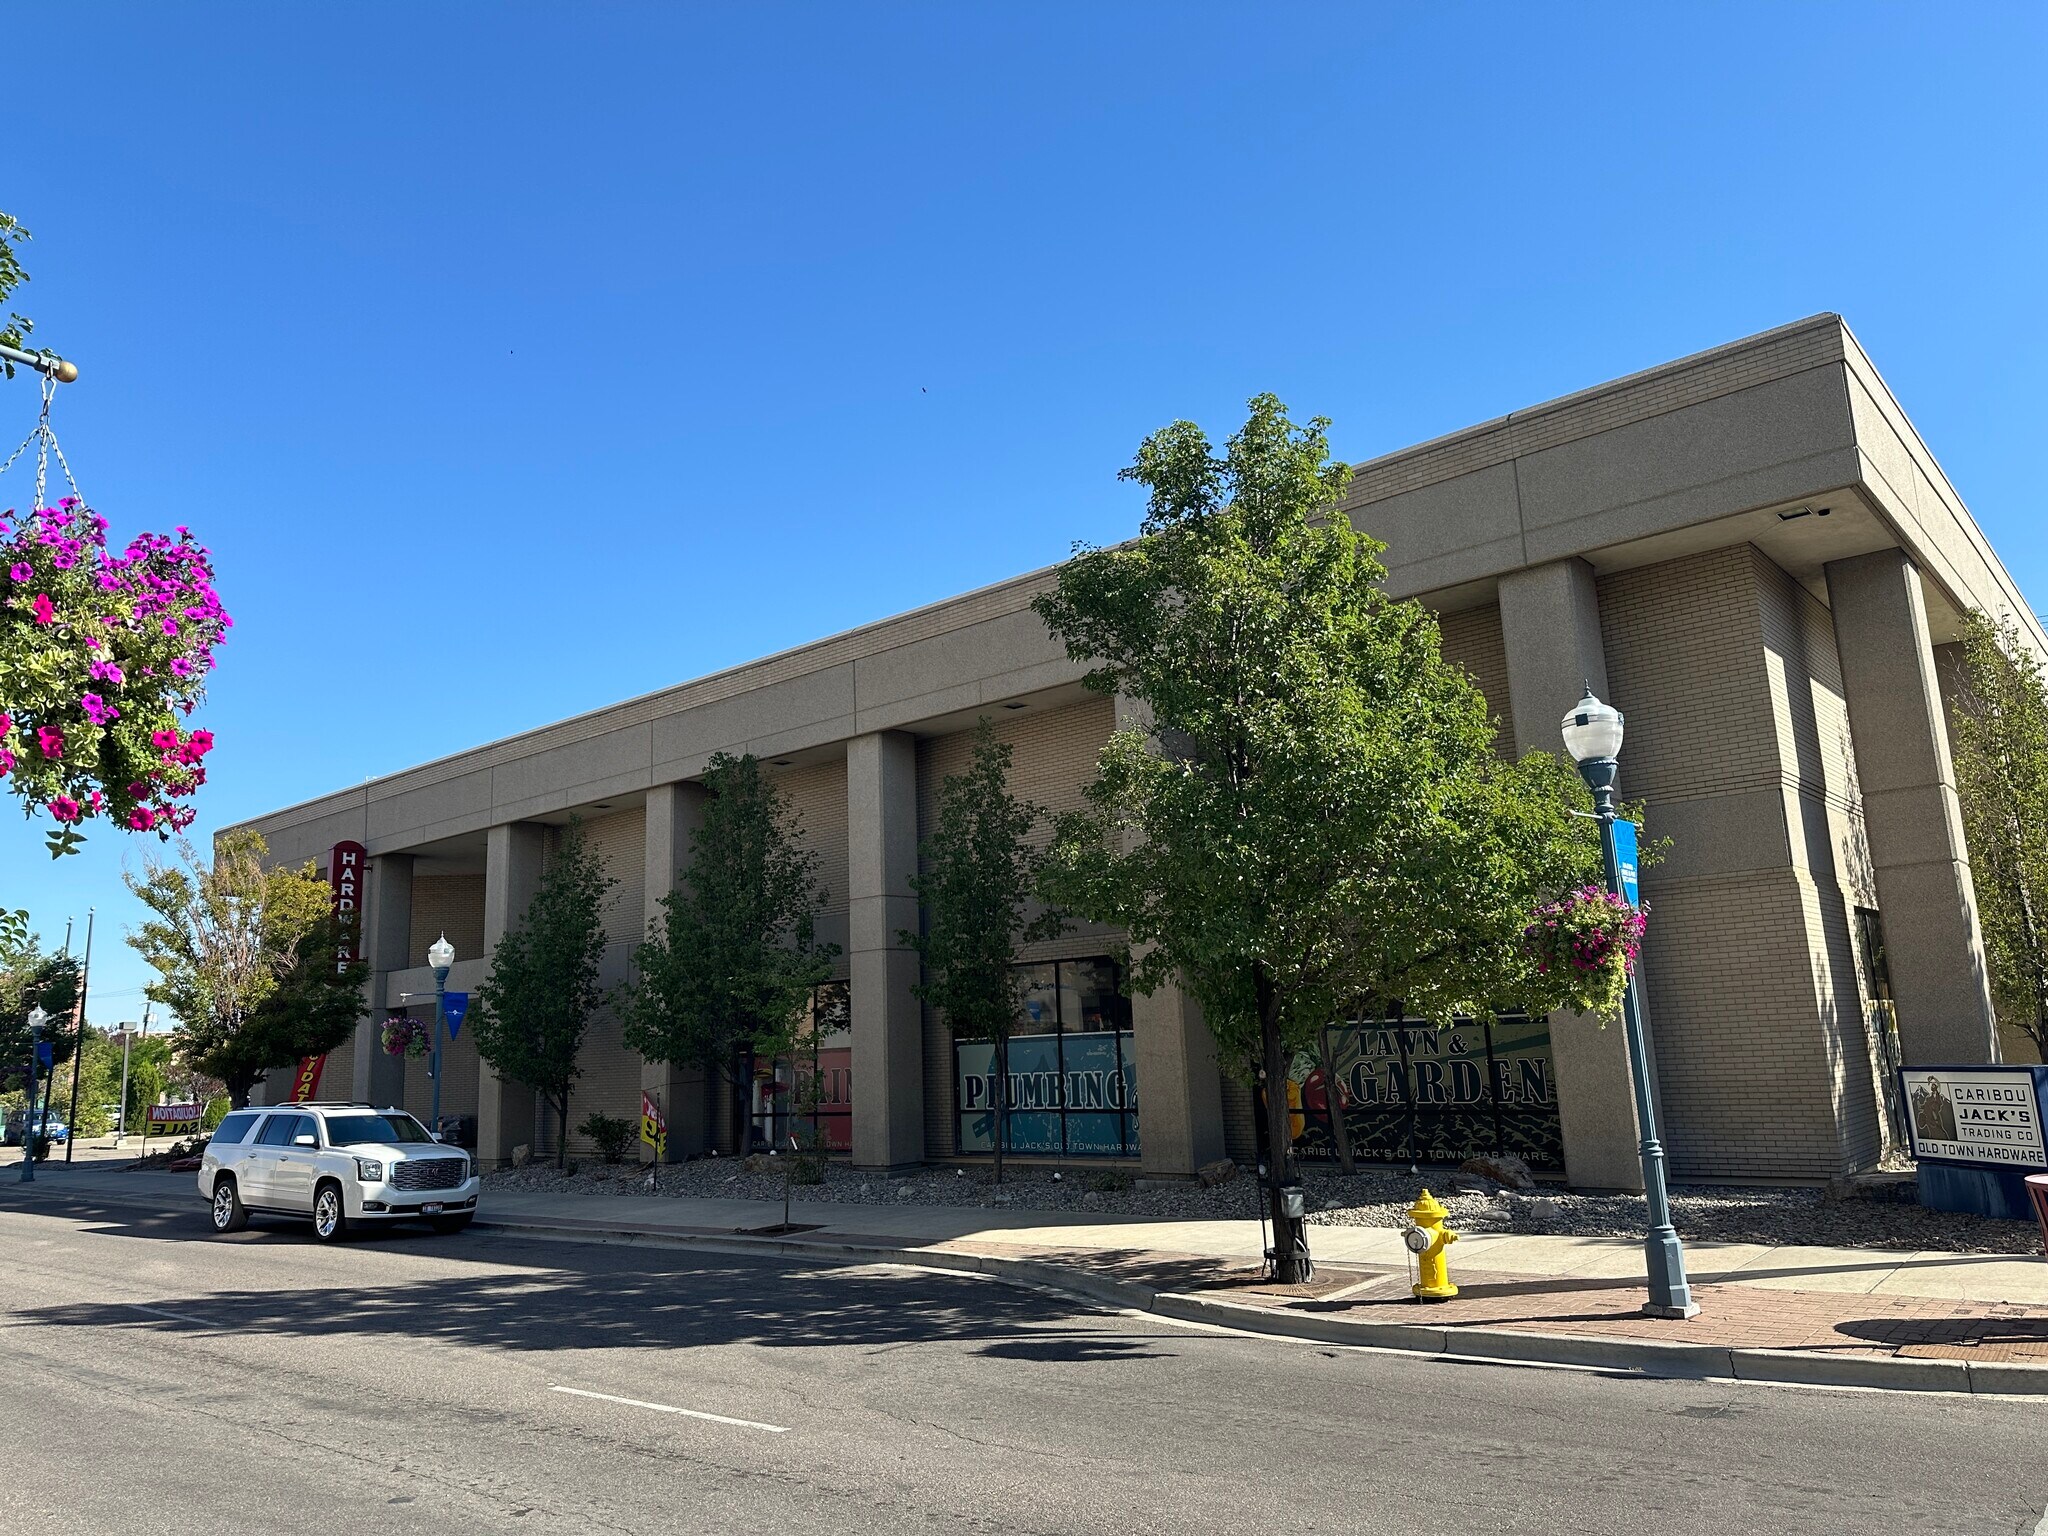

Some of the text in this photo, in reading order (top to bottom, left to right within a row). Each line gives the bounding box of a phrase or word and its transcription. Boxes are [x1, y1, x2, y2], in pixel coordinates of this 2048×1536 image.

[1358, 1028, 1469, 1057] LAWN &
[1349, 1058, 1549, 1104] GARDEN
[963, 1070, 1128, 1110] PLUMBING
[1954, 1088, 2027, 1102] CARIBOU
[1959, 1108, 2031, 1123] JACK'S
[1961, 1127, 2033, 1141] TRADING CO
[980, 1141, 1017, 1149] CARBU
[1020, 1141, 1051, 1150] JACK'S
[1053, 1142, 1070, 1150] OLD
[1072, 1143, 1100, 1151] TOWN
[1918, 1142, 2045, 1163] OLD TOWN HARDWARE
[1397, 1149, 1423, 1158] OLD
[1428, 1149, 1467, 1159] TOWN
